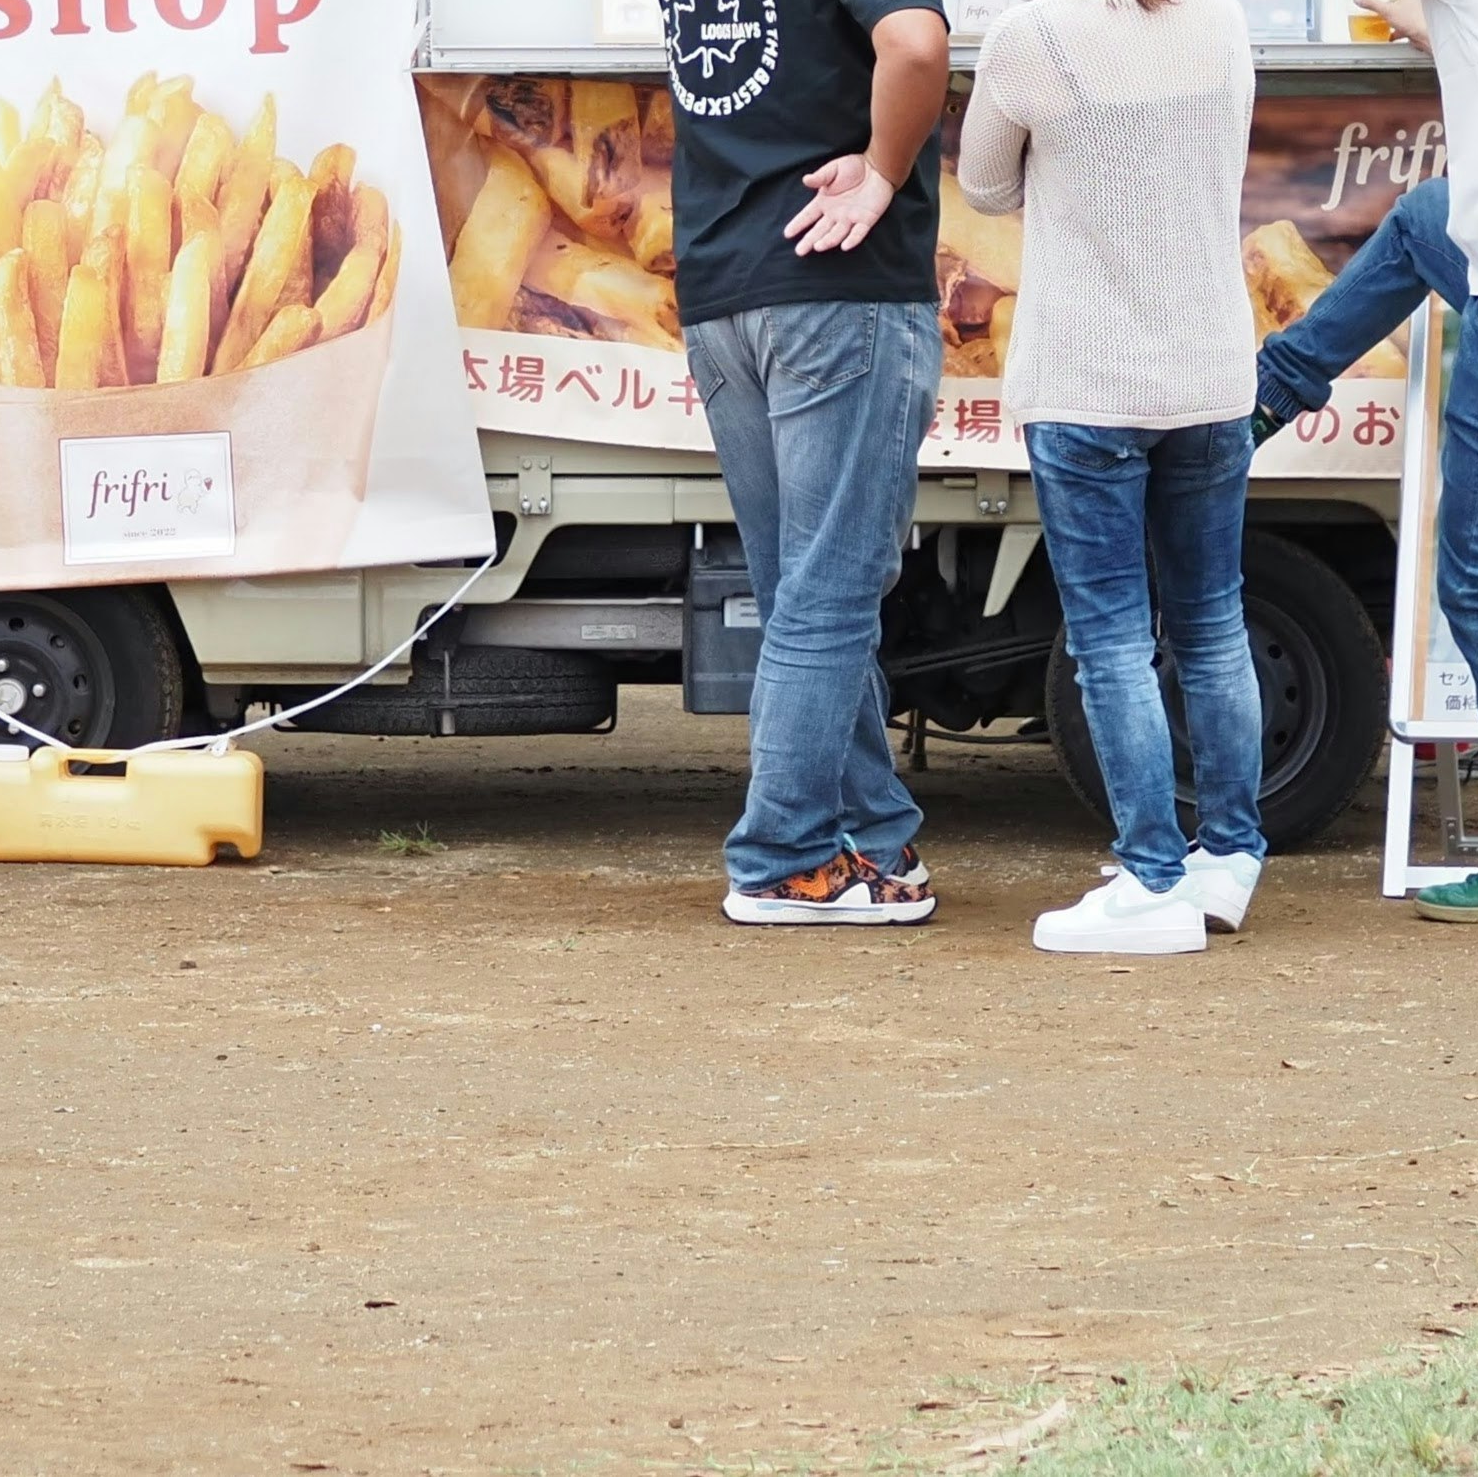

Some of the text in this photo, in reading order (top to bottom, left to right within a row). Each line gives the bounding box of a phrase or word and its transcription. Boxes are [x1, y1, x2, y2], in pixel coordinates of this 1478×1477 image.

[731, 20, 762, 41] DAYS
[761, 27, 779, 71] THE
[731, 66, 771, 111] BEST
[86, 469, 173, 519] frifri
[123, 530, 148, 539] since
